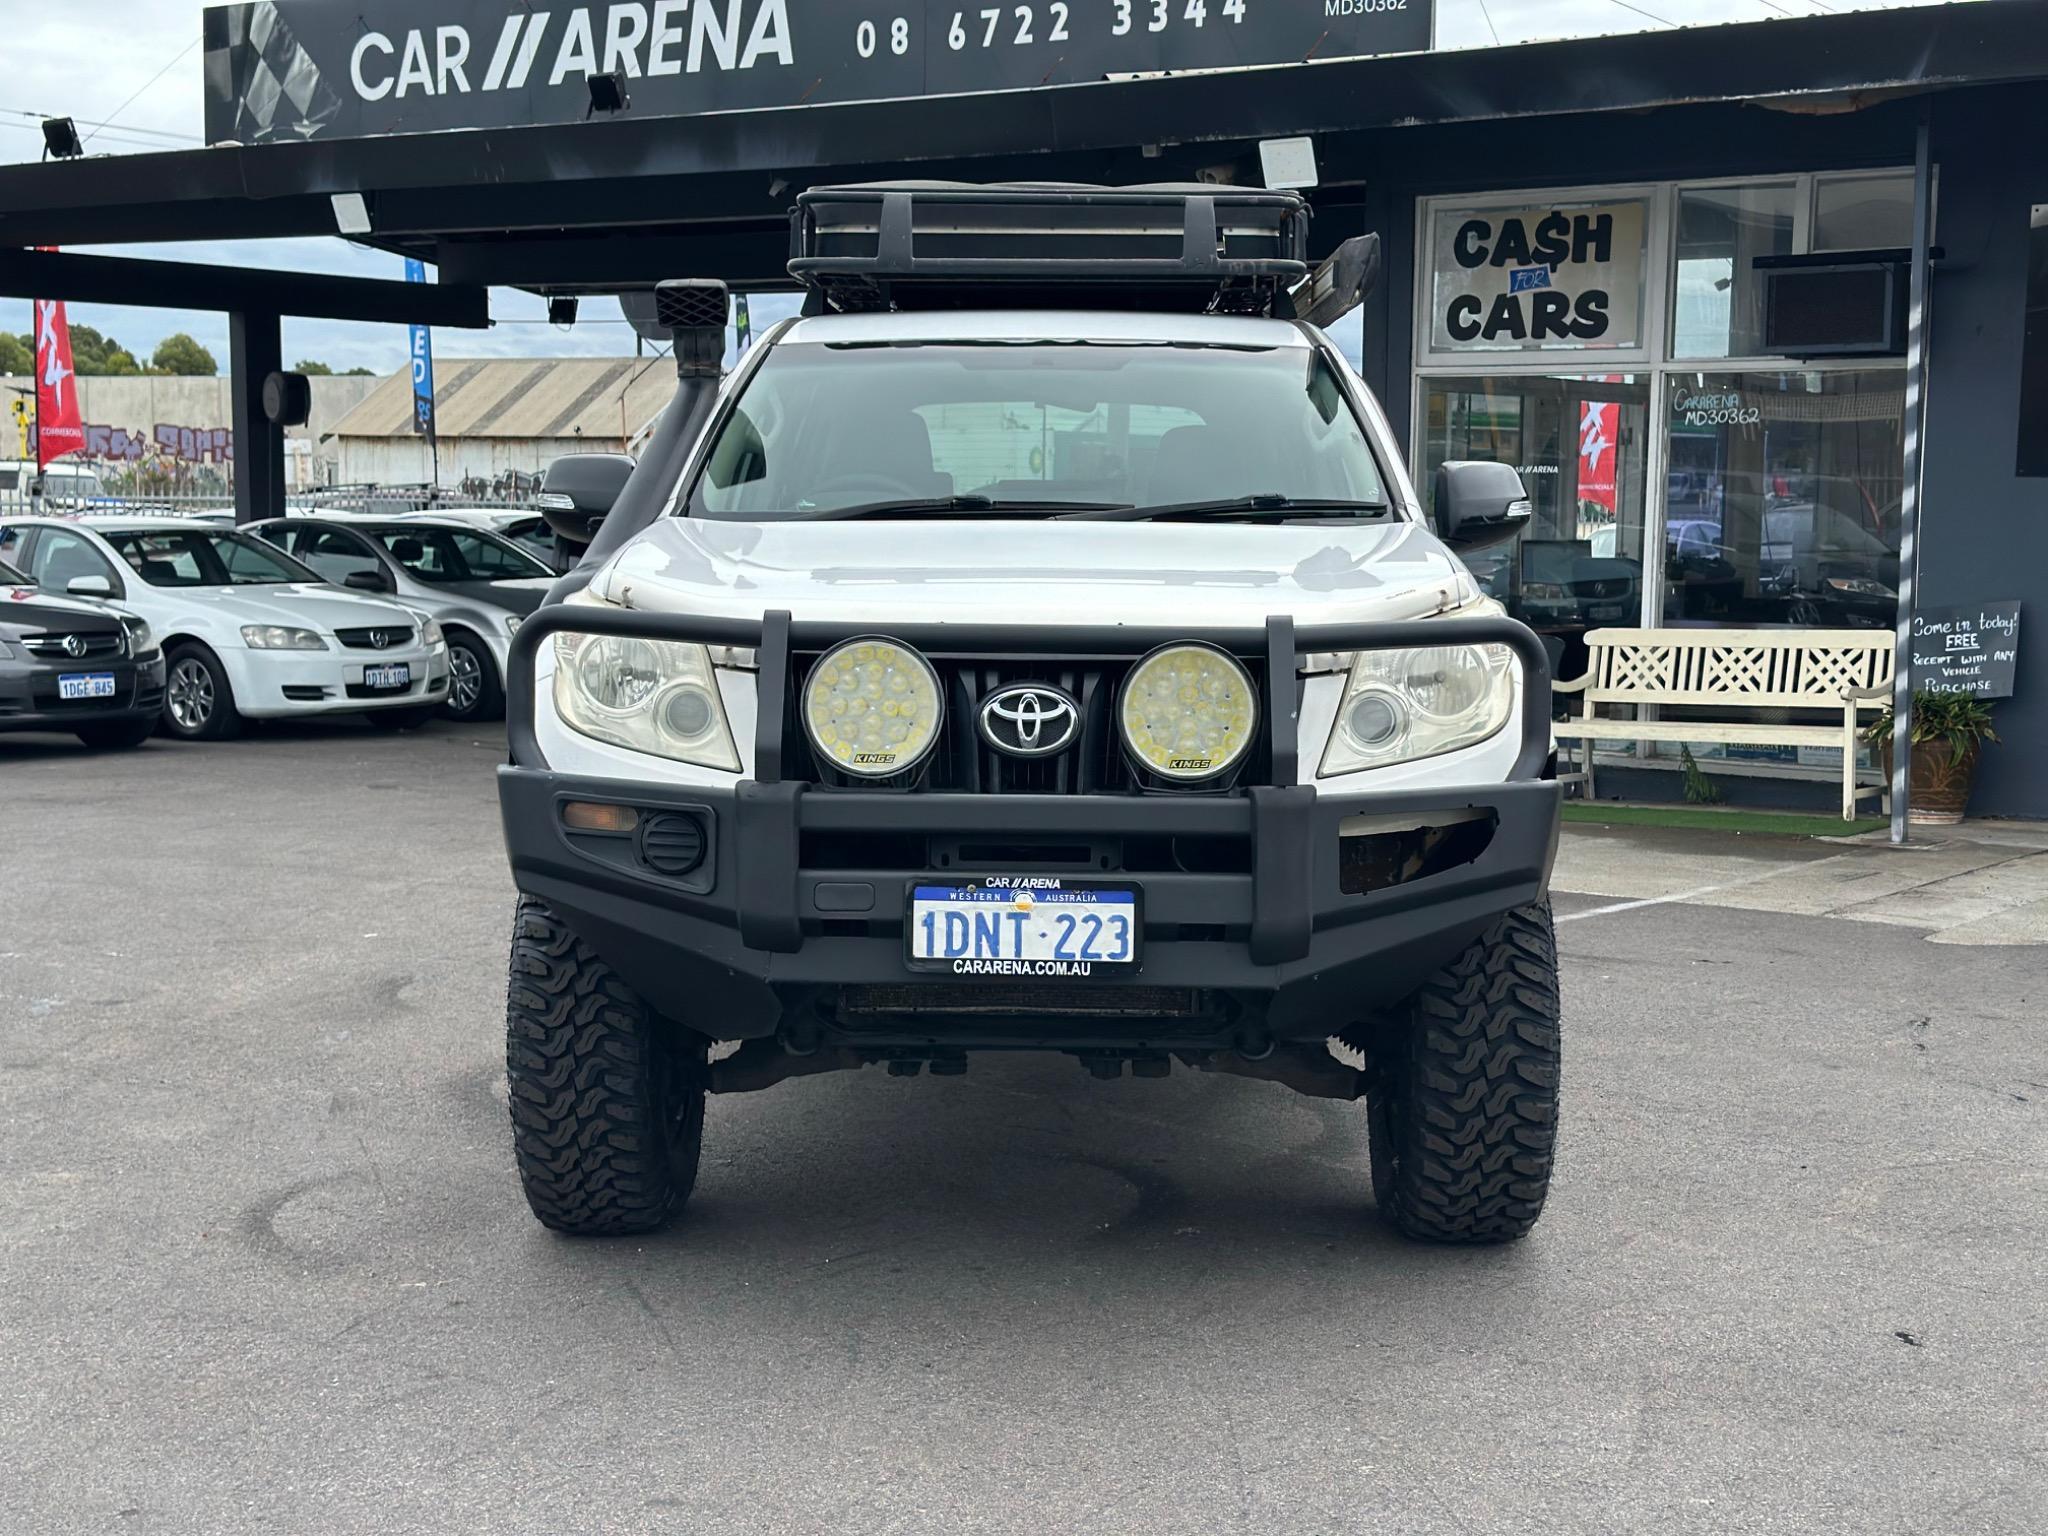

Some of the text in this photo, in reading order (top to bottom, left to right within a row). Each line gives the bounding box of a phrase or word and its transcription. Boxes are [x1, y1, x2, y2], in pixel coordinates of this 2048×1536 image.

[856, 17, 909, 59] 08
[947, 2, 1070, 51] 6722
[350, 25, 471, 101] CAR
[548, 0, 794, 85] ARENA
[1514, 269, 1546, 290] FOR
[1446, 289, 1610, 341] CARS
[1684, 407, 1760, 426] MD30362
[1532, 465, 1559, 474] ARENA
[1913, 611, 2018, 637] Come in today!
[1945, 633, 1980, 649] FREE
[1961, 653, 1987, 665] WITH
[1993, 650, 2016, 662] ANY
[1941, 665, 1982, 677] VEHICLE
[1924, 677, 1992, 693] PURCHASE
[854, 754, 896, 763] KINGS
[1169, 760, 1211, 768] KINGS
[985, 877, 1010, 888] CAR
[1021, 878, 1061, 889] ARENA
[950, 892, 1097, 903] WESTERN AUSTRALIA
[953, 960, 1091, 976] CARARENA.COM.AU
